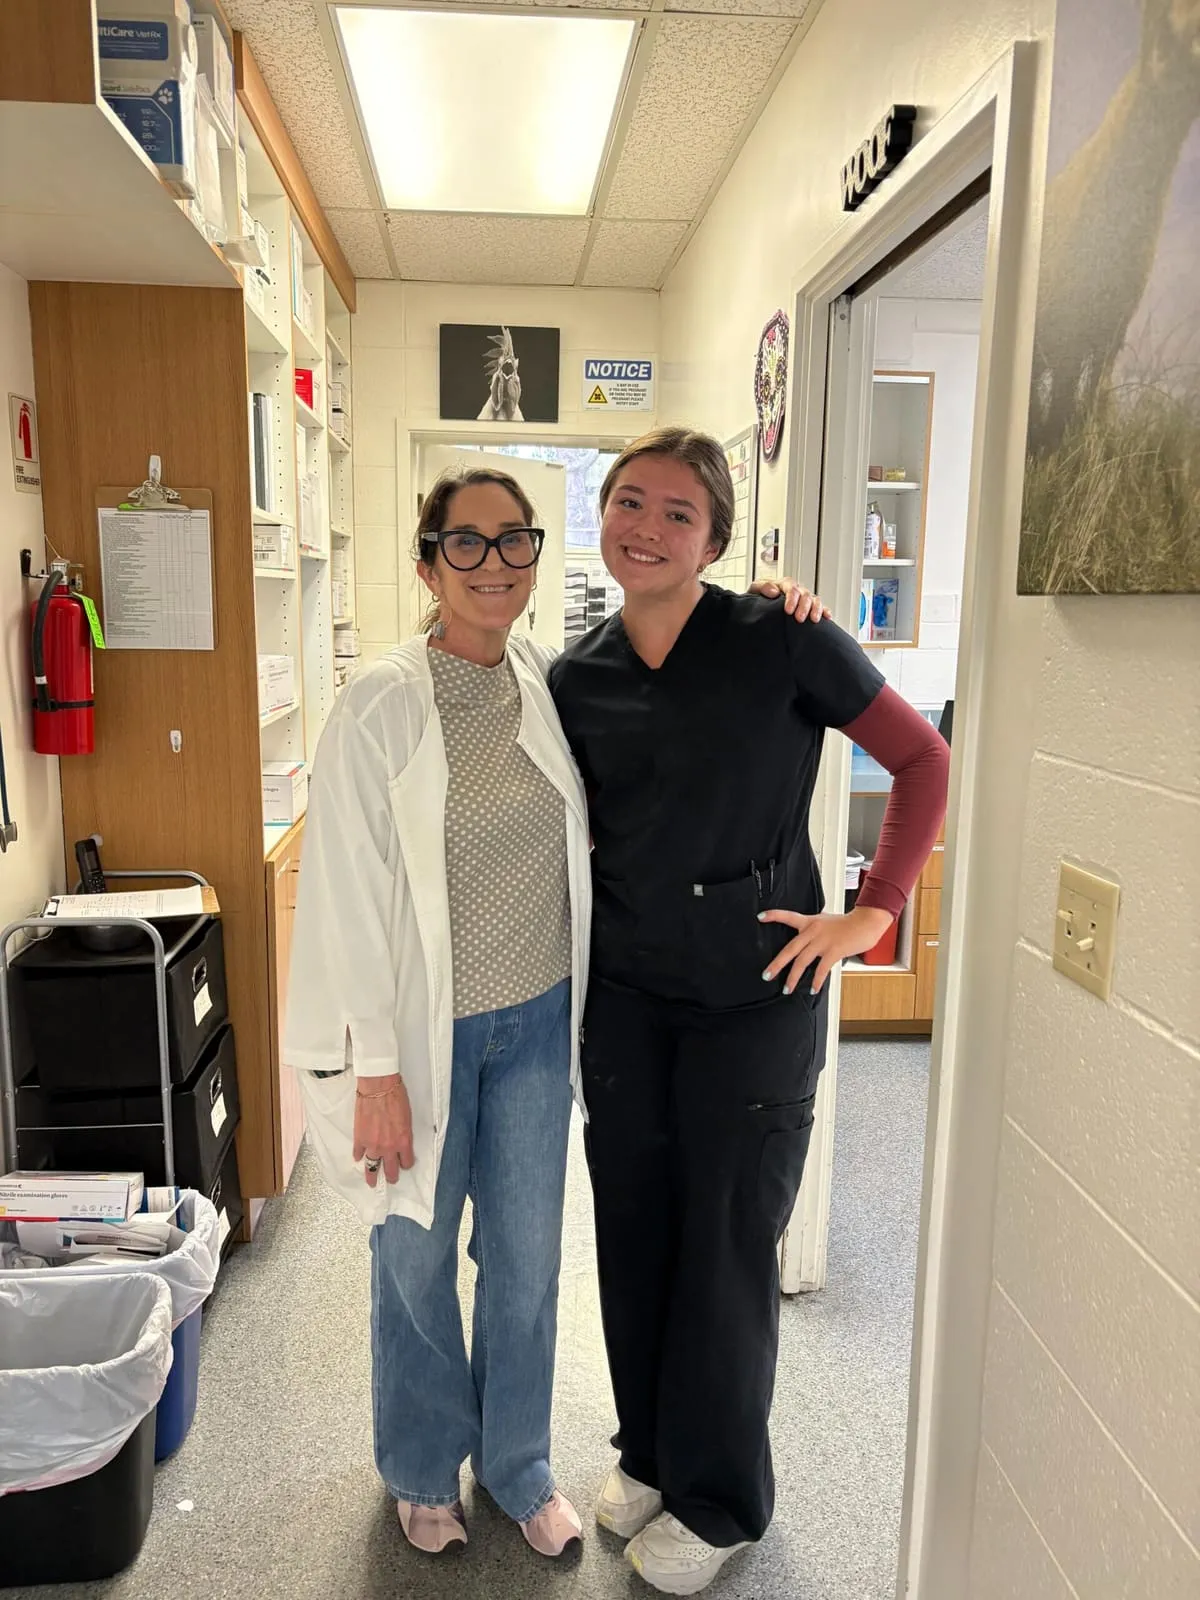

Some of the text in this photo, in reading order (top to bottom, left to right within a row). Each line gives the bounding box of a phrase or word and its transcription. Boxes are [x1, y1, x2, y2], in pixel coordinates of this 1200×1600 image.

[99, 26, 135, 37] ltiCare
[840, 104, 904, 211] WOOF
[588, 362, 650, 377] NOTICE
[16, 465, 24, 474] FIRE
